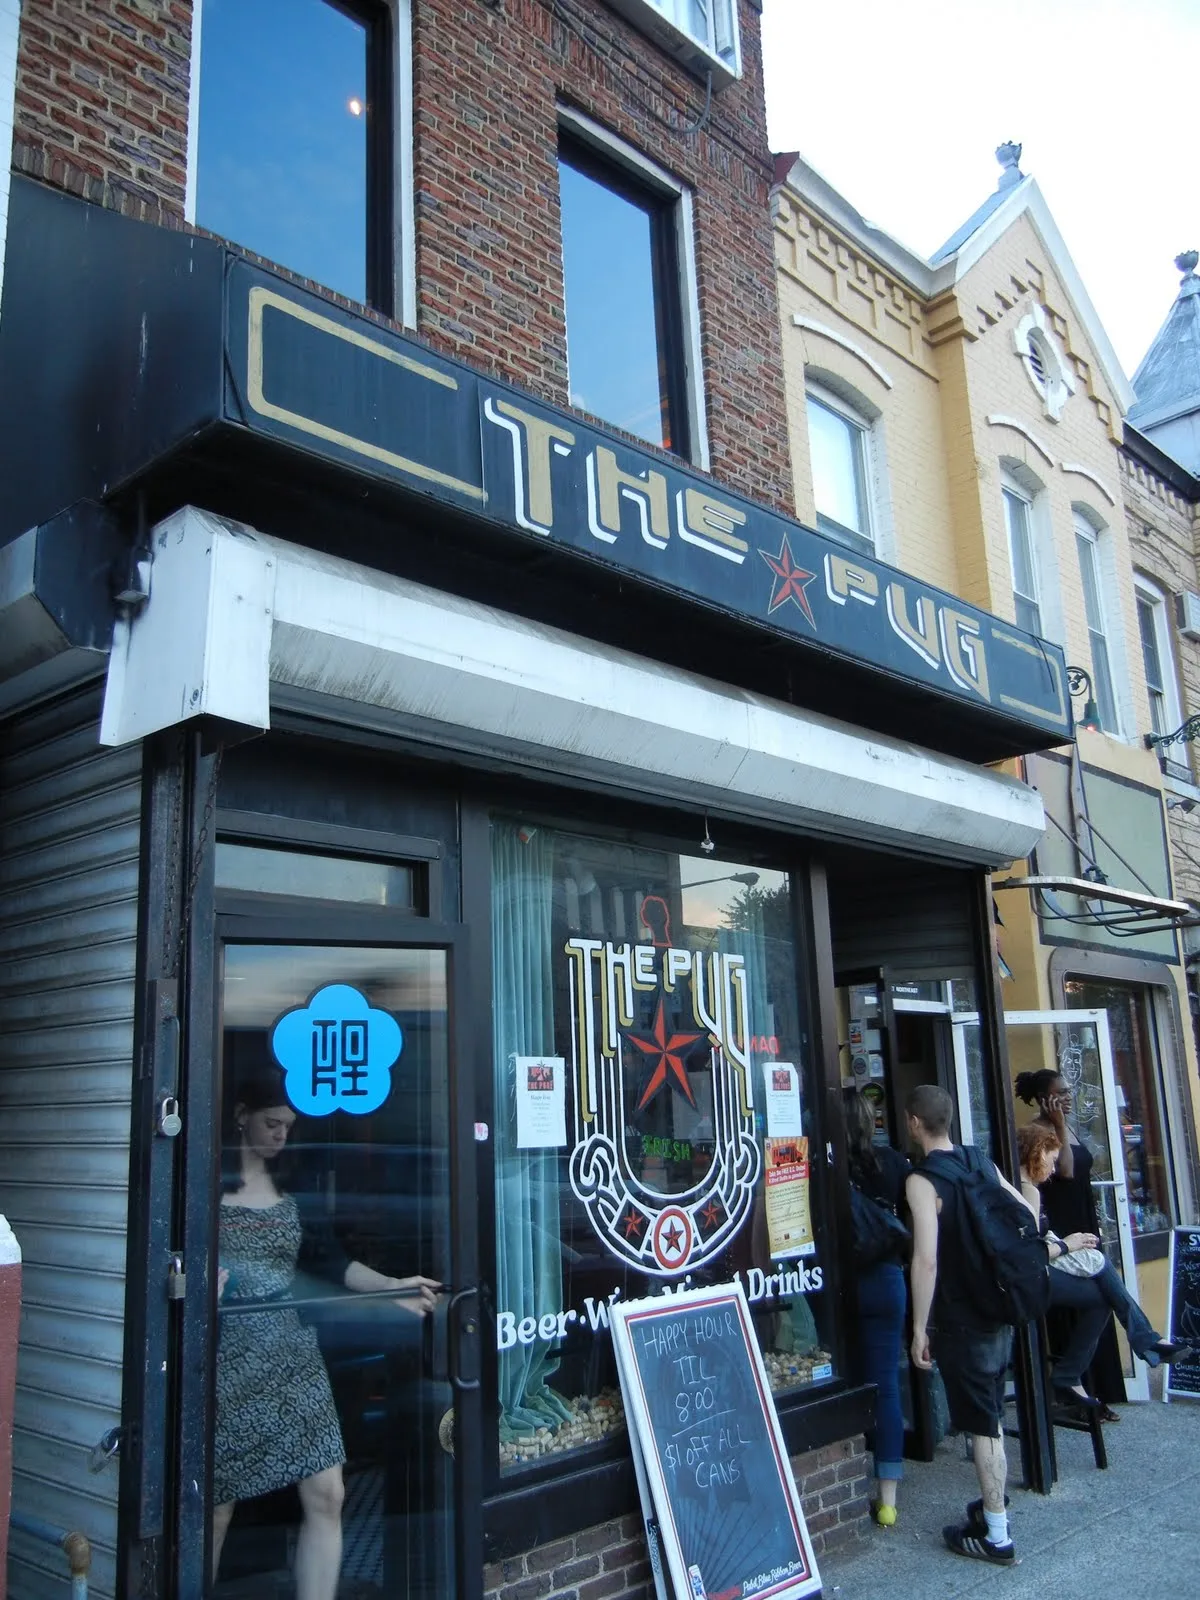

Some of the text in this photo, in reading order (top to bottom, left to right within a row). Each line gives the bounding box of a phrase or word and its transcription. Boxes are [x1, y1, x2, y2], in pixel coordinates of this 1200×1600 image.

[484, 397, 990, 702] THE PUG
[565, 938, 657, 1122] THE
[663, 948, 753, 1117] PUG
[497, 1308, 576, 1350] Beer
[746, 1260, 823, 1301] Drinks
[641, 1311, 738, 1359] HAPPY HOUR
[672, 1355, 716, 1385] TIL
[675, 1387, 714, 1422] 8:00
[665, 1424, 752, 1475] $1 OFF ALL
[695, 1459, 740, 1488] CANS
[757, 1574, 771, 1589] Blue
[770, 1566, 789, 1583] Ribbon
[788, 1561, 802, 1575] Beer
